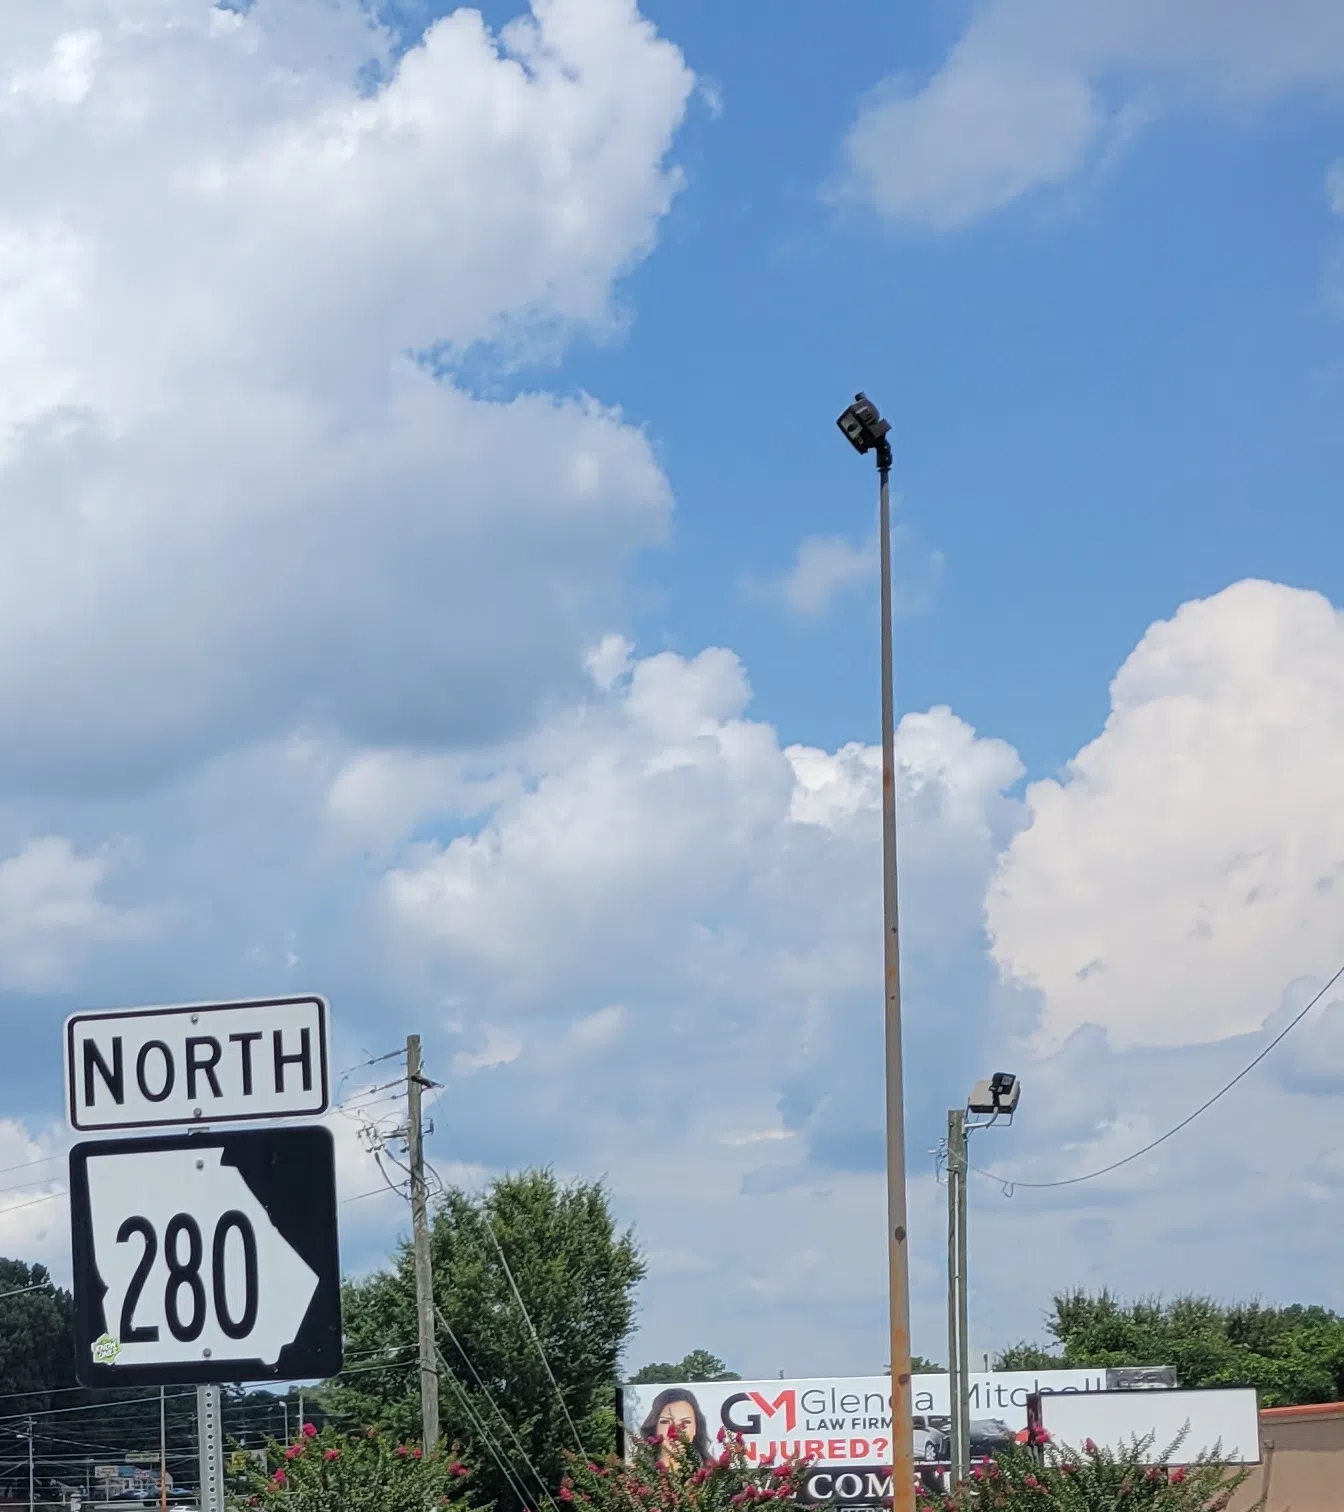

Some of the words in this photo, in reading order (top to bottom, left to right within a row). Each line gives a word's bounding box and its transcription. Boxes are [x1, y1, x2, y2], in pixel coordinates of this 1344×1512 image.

[83, 1027, 312, 1107] NORTH
[116, 1209, 260, 1344] 280
[801, 1385, 934, 1415] Glena
[806, 1418, 846, 1431] LAW
[851, 1417, 893, 1430] FIRM
[728, 1436, 889, 1462] NJURED?
[807, 1472, 921, 1500] COM
